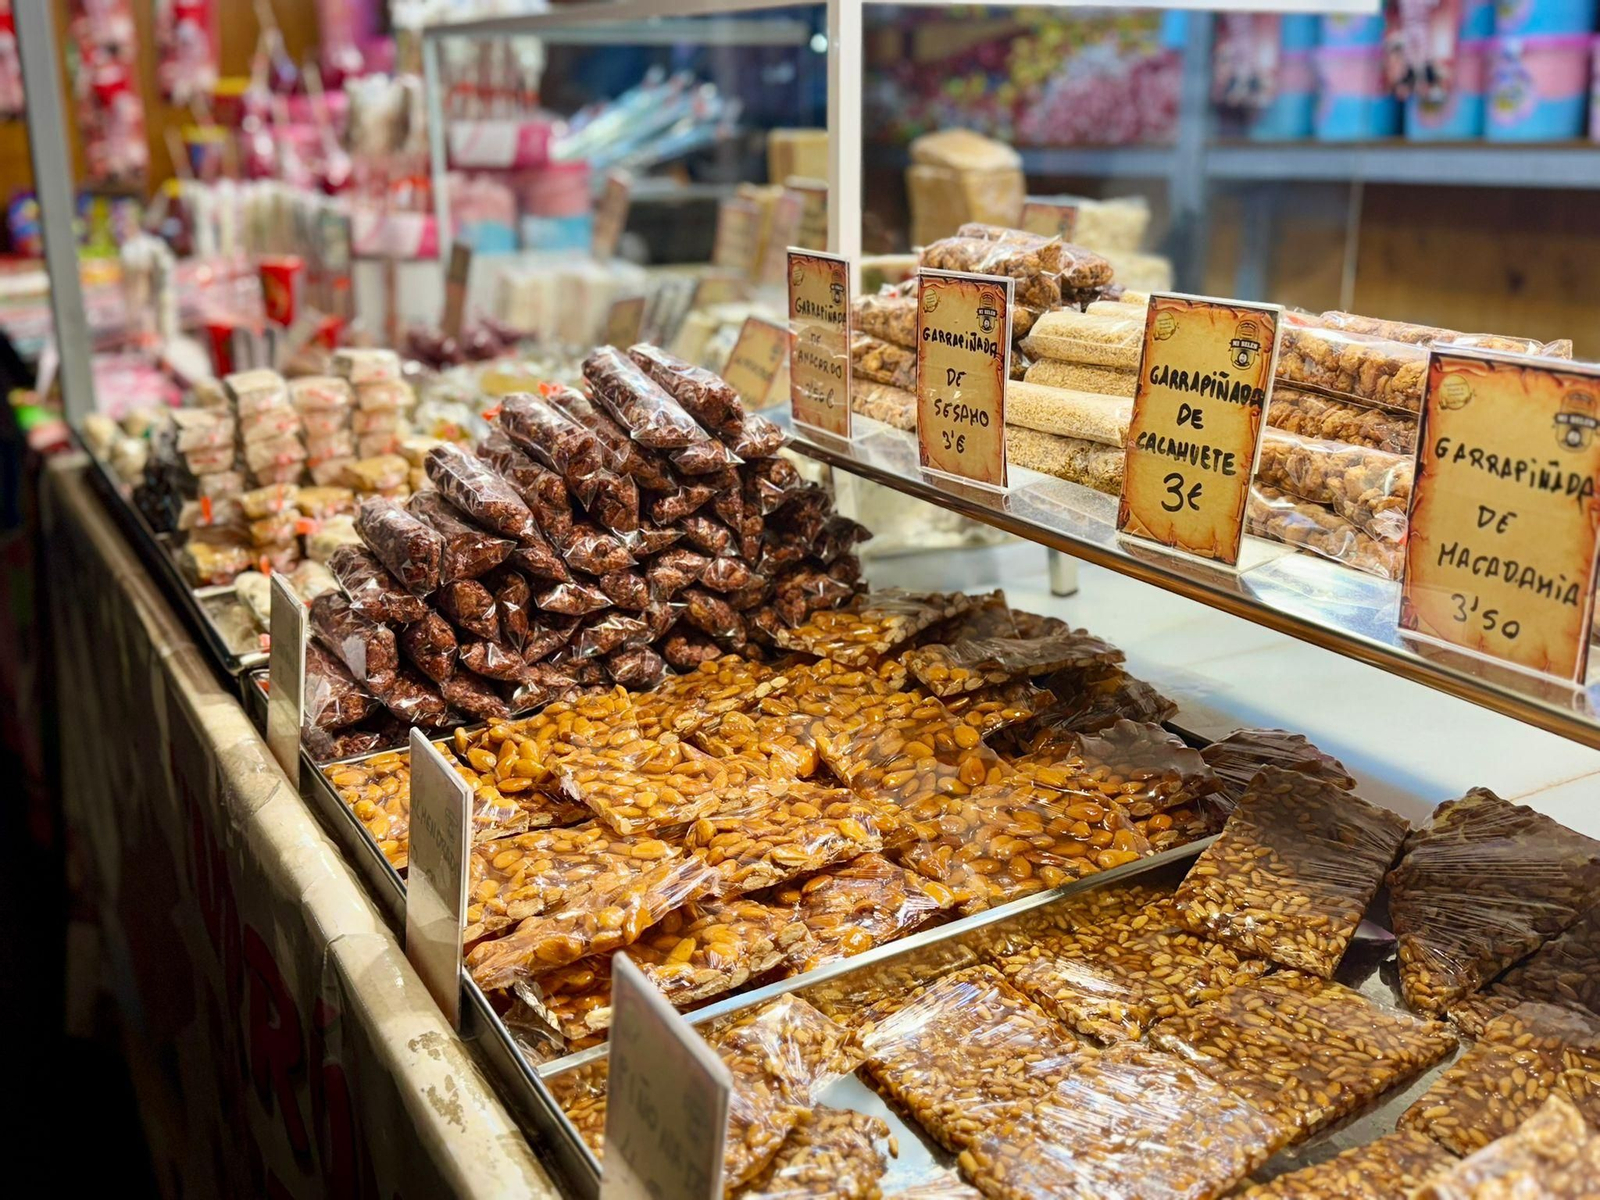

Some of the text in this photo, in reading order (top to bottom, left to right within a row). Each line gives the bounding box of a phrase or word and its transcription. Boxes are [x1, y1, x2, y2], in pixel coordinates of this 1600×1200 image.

[946, 368, 967, 387] DE
[934, 398, 989, 427] SESAMO
[1176, 403, 1204, 430] DE
[1135, 431, 1237, 476] CACAHUETE
[1161, 472, 1203, 512] 3€
[1477, 505, 1517, 534] DE
[1451, 593, 1520, 639] 3'50
